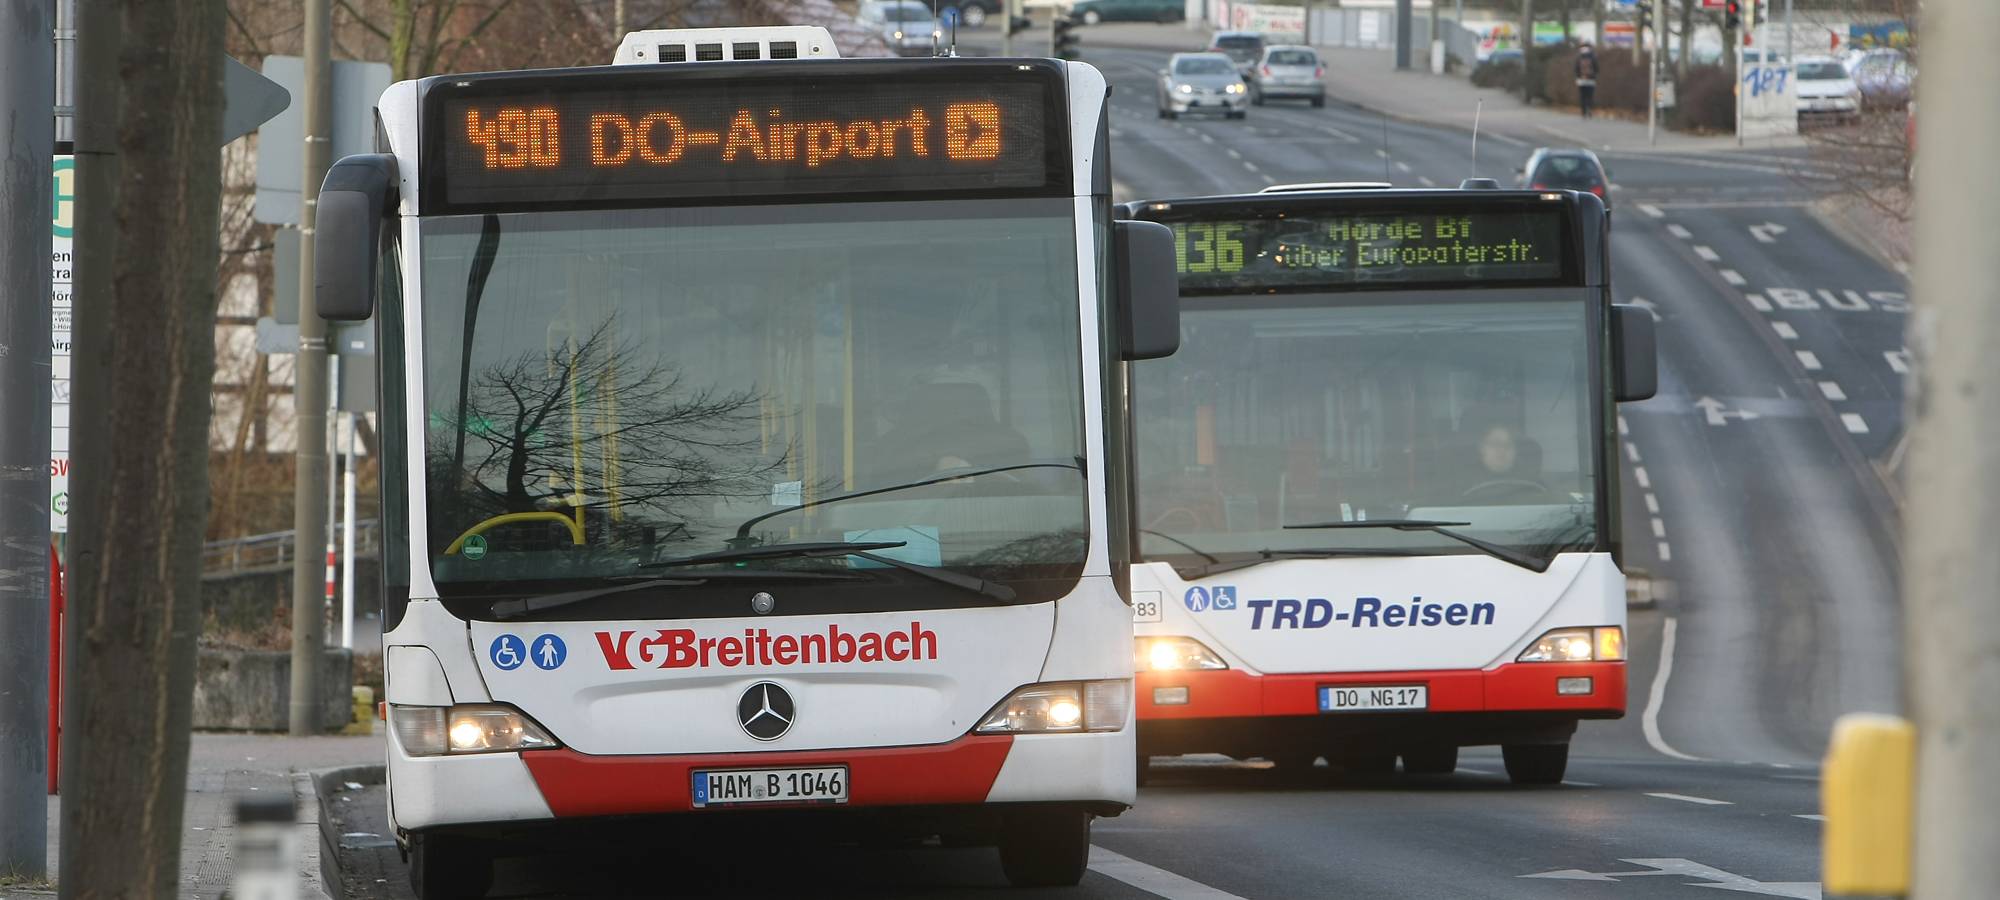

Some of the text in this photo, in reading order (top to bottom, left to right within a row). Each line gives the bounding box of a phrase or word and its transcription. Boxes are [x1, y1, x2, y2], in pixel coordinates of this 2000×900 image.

[468, 107, 931, 168] 490 DO-Airport
[1436, 217, 1472, 239] Bf
[1175, 224, 1244, 273] 136
[1765, 287, 1910, 313] BUS
[1247, 597, 1496, 630] TRD-Reisen
[1336, 689, 1418, 706] DO NG 17
[709, 772, 841, 799] HAM B 1046
